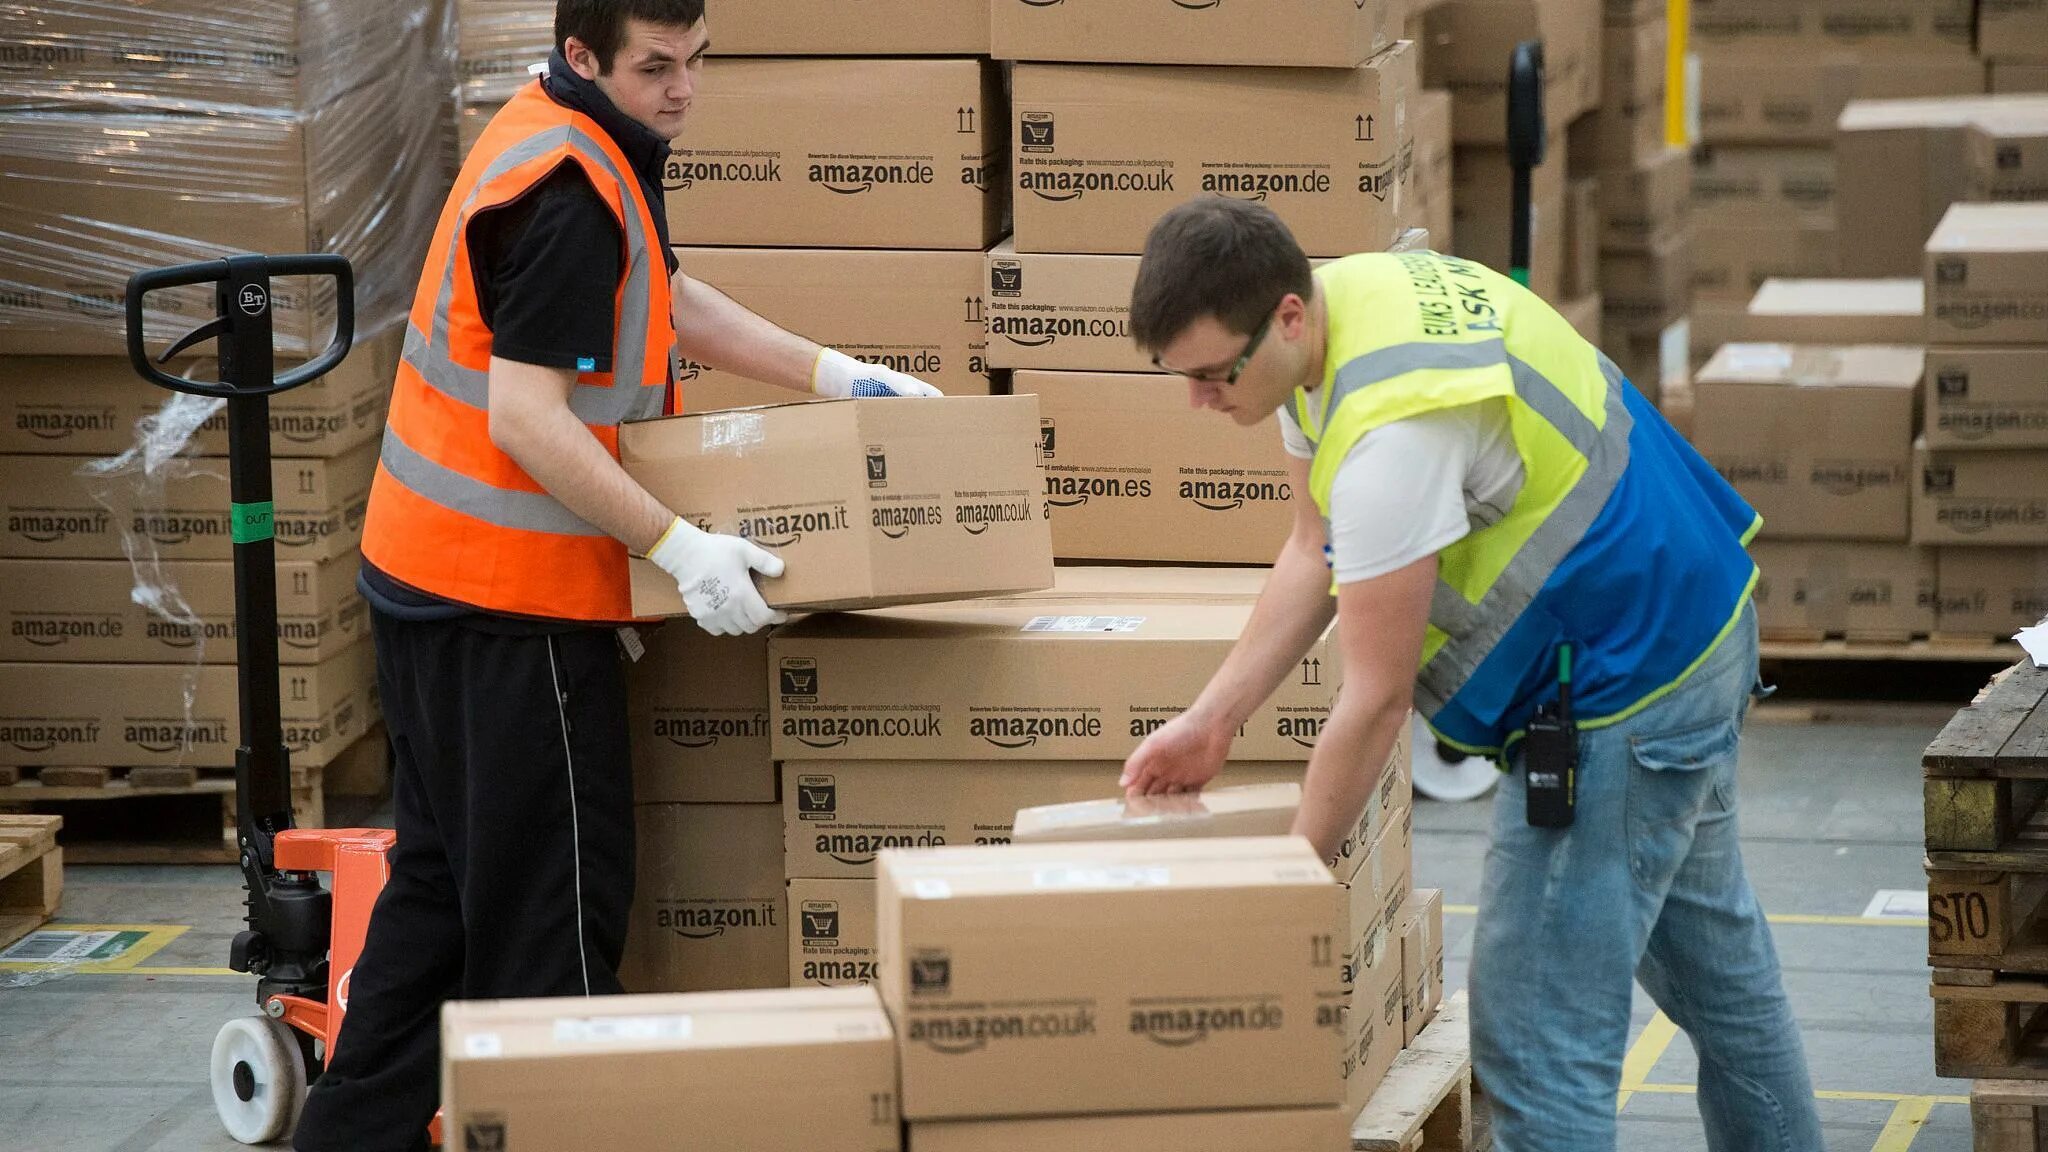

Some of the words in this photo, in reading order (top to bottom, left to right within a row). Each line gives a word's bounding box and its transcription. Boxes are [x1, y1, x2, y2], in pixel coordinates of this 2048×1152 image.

[662, 159, 781, 181] azon.co.uk
[808, 161, 934, 184] amazon.de
[1048, 159, 1085, 167] packaging:
[1019, 168, 1174, 191] amazon.co.uk
[1202, 169, 1330, 192] amazon.de
[1007, 303, 1020, 311] this
[1021, 304, 1057, 312] packaging:
[1454, 281, 1504, 332] ASK
[1209, 468, 1245, 476] packaging:
[739, 506, 849, 538] amazon.it
[872, 506, 942, 527] amazon.es
[956, 498, 1031, 523] amazon.co.uk
[8, 512, 110, 534] amazon.fr
[11, 617, 123, 637] amazon.de
[812, 704, 848, 713] packaging:
[654, 713, 769, 737] amazon.fr
[782, 712, 942, 737] amazon.co.uk
[969, 712, 1102, 737] amazon.de
[815, 830, 946, 854] amazonde
[657, 903, 777, 928] amazon.it
[834, 948, 870, 956] packaging:
